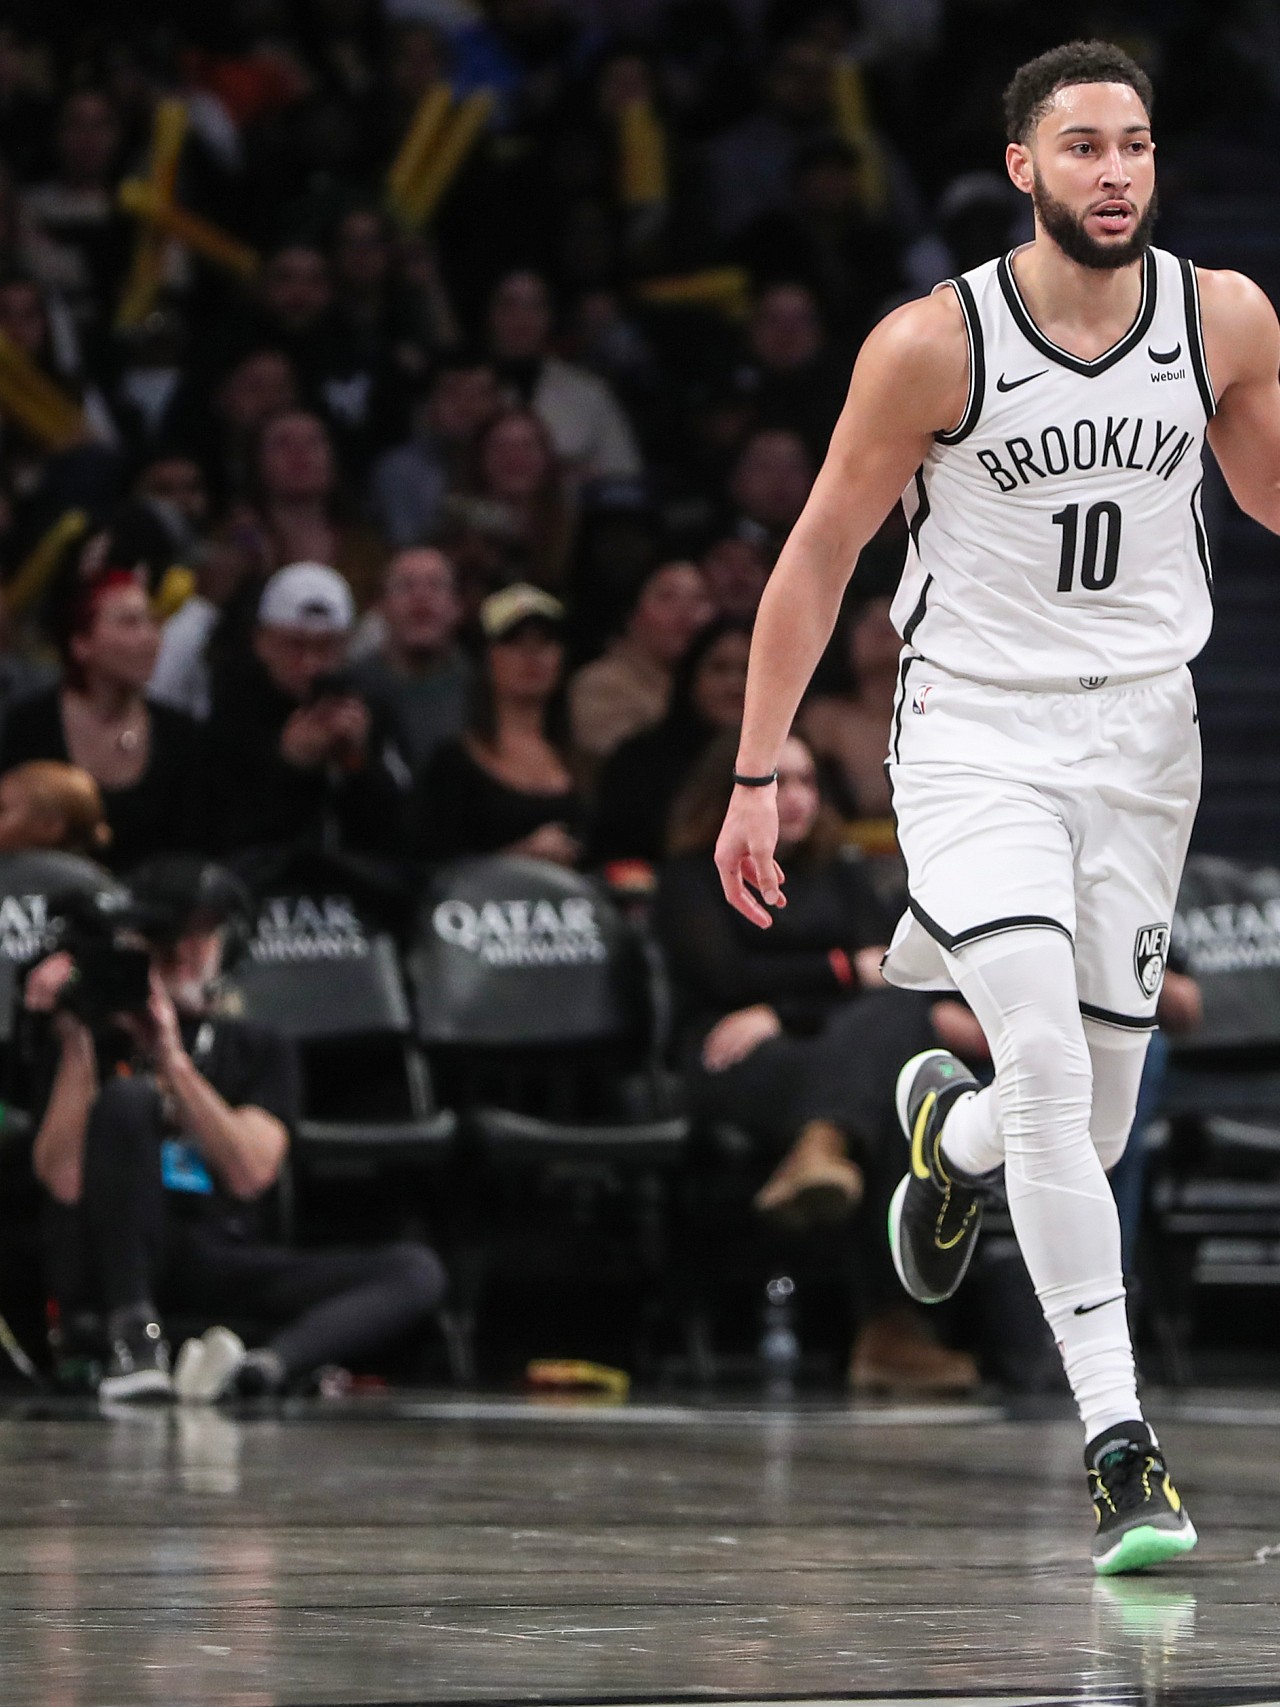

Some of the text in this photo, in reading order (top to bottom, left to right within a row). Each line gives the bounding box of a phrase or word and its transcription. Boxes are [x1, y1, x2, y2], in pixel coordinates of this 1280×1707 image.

[1150, 368, 1186, 383] Webull
[976, 416, 1195, 492] BROOKLYN
[1052, 500, 1122, 593] 10
[432, 898, 602, 951] QATAR
